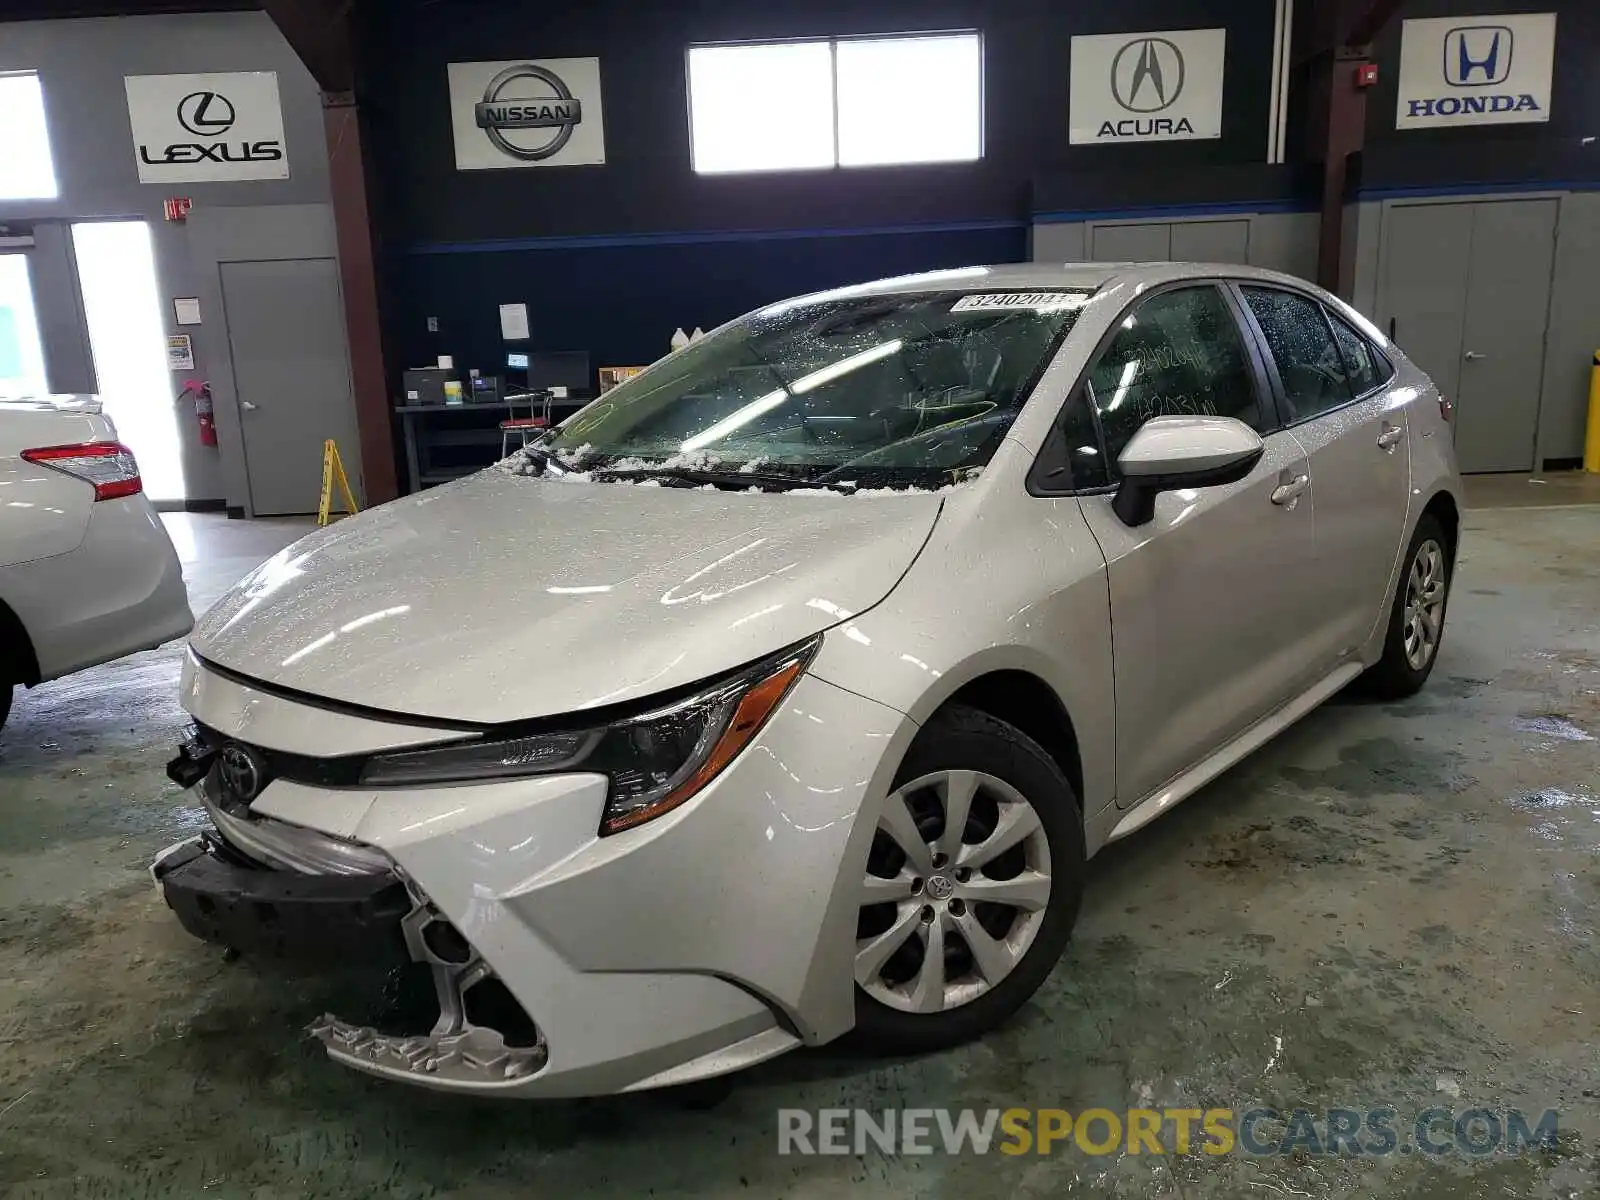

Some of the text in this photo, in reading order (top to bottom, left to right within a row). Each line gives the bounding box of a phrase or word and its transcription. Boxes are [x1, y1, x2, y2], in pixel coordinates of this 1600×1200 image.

[485, 105, 570, 121] NISSAN
[1406, 94, 1541, 117] HONDA
[1096, 117, 1194, 137] ACURA
[140, 141, 281, 164] LEXUS
